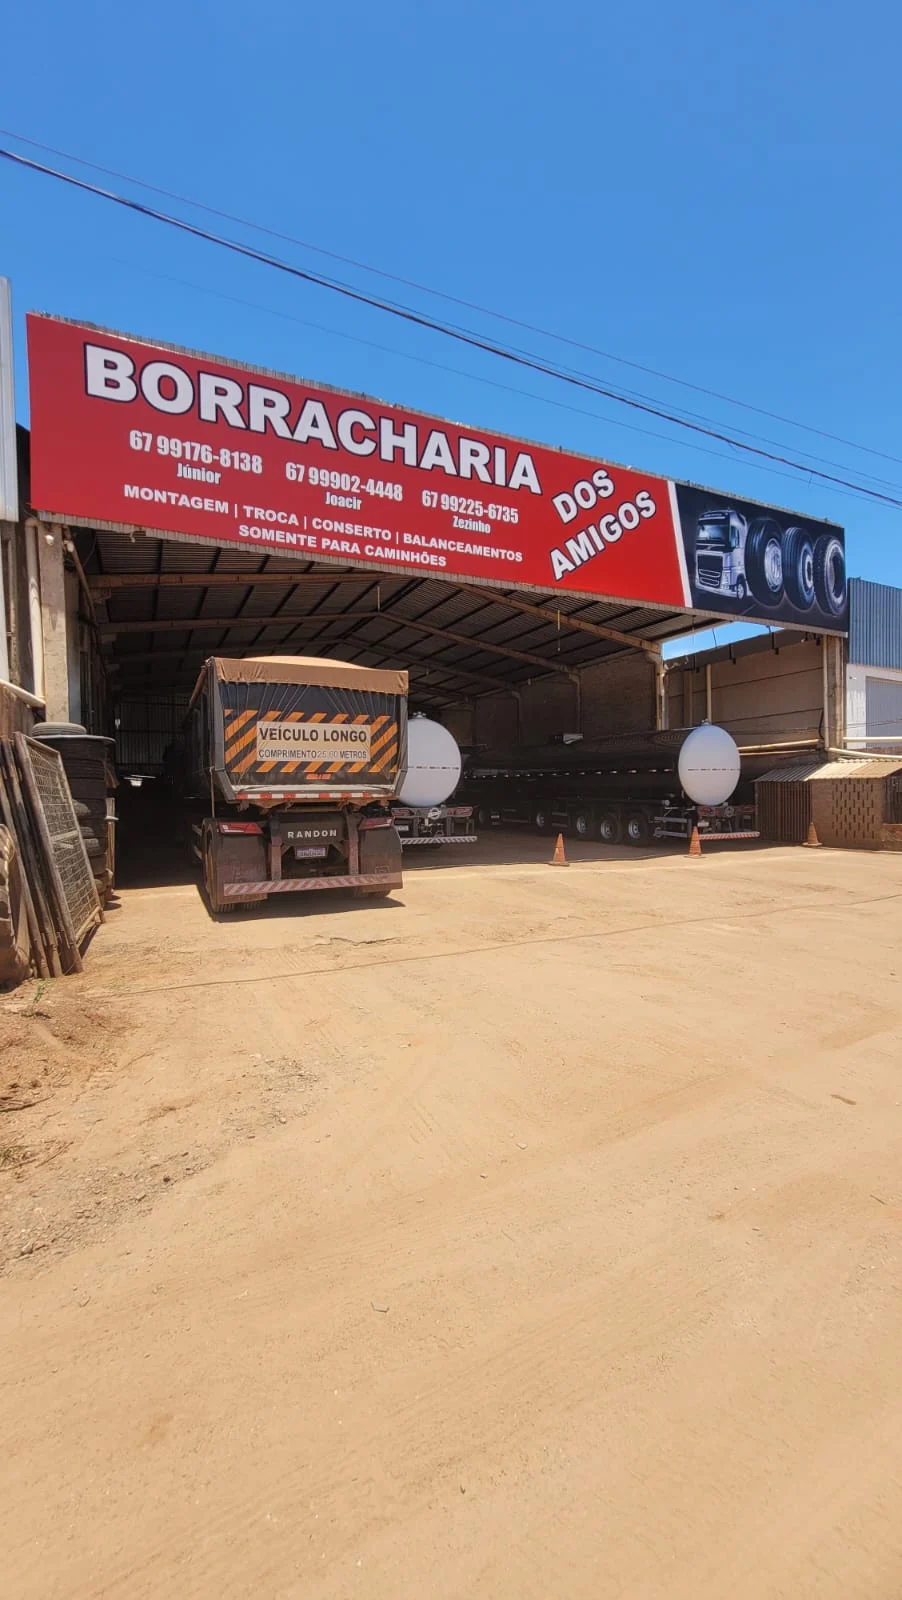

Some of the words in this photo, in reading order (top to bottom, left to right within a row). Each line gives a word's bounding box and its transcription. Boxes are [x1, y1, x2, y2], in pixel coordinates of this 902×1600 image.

[84, 342, 543, 495] BORRACHARIA
[129, 430, 153, 452] 67
[156, 435, 263, 474] 99176-8138
[177, 462, 221, 484] Júnior
[285, 462, 305, 482] 67
[308, 466, 403, 501] 99902-4448
[325, 491, 362, 510] Joacir
[422, 489, 438, 508] 67
[440, 493, 519, 523] 99225-6735
[551, 468, 616, 525] DOS
[123, 484, 229, 514] MONTAGEM
[243, 505, 299, 526] TROCA
[311, 517, 392, 541] CONSERTO
[403, 532, 524, 562] BALANCEAMENTOS
[452, 515, 491, 534] Zezinho
[549, 489, 657, 582] AMIGOS
[238, 524, 317, 548] SOMENTE
[321, 537, 361, 555] PARA
[365, 544, 447, 567] CAMINHÕES
[259, 726, 319, 742] VEÍCULO
[323, 730, 367, 743] LONGO
[258, 749, 317, 759] COMPRIMENTO
[339, 750, 367, 759] METROS
[287, 829, 337, 839] RANDON
